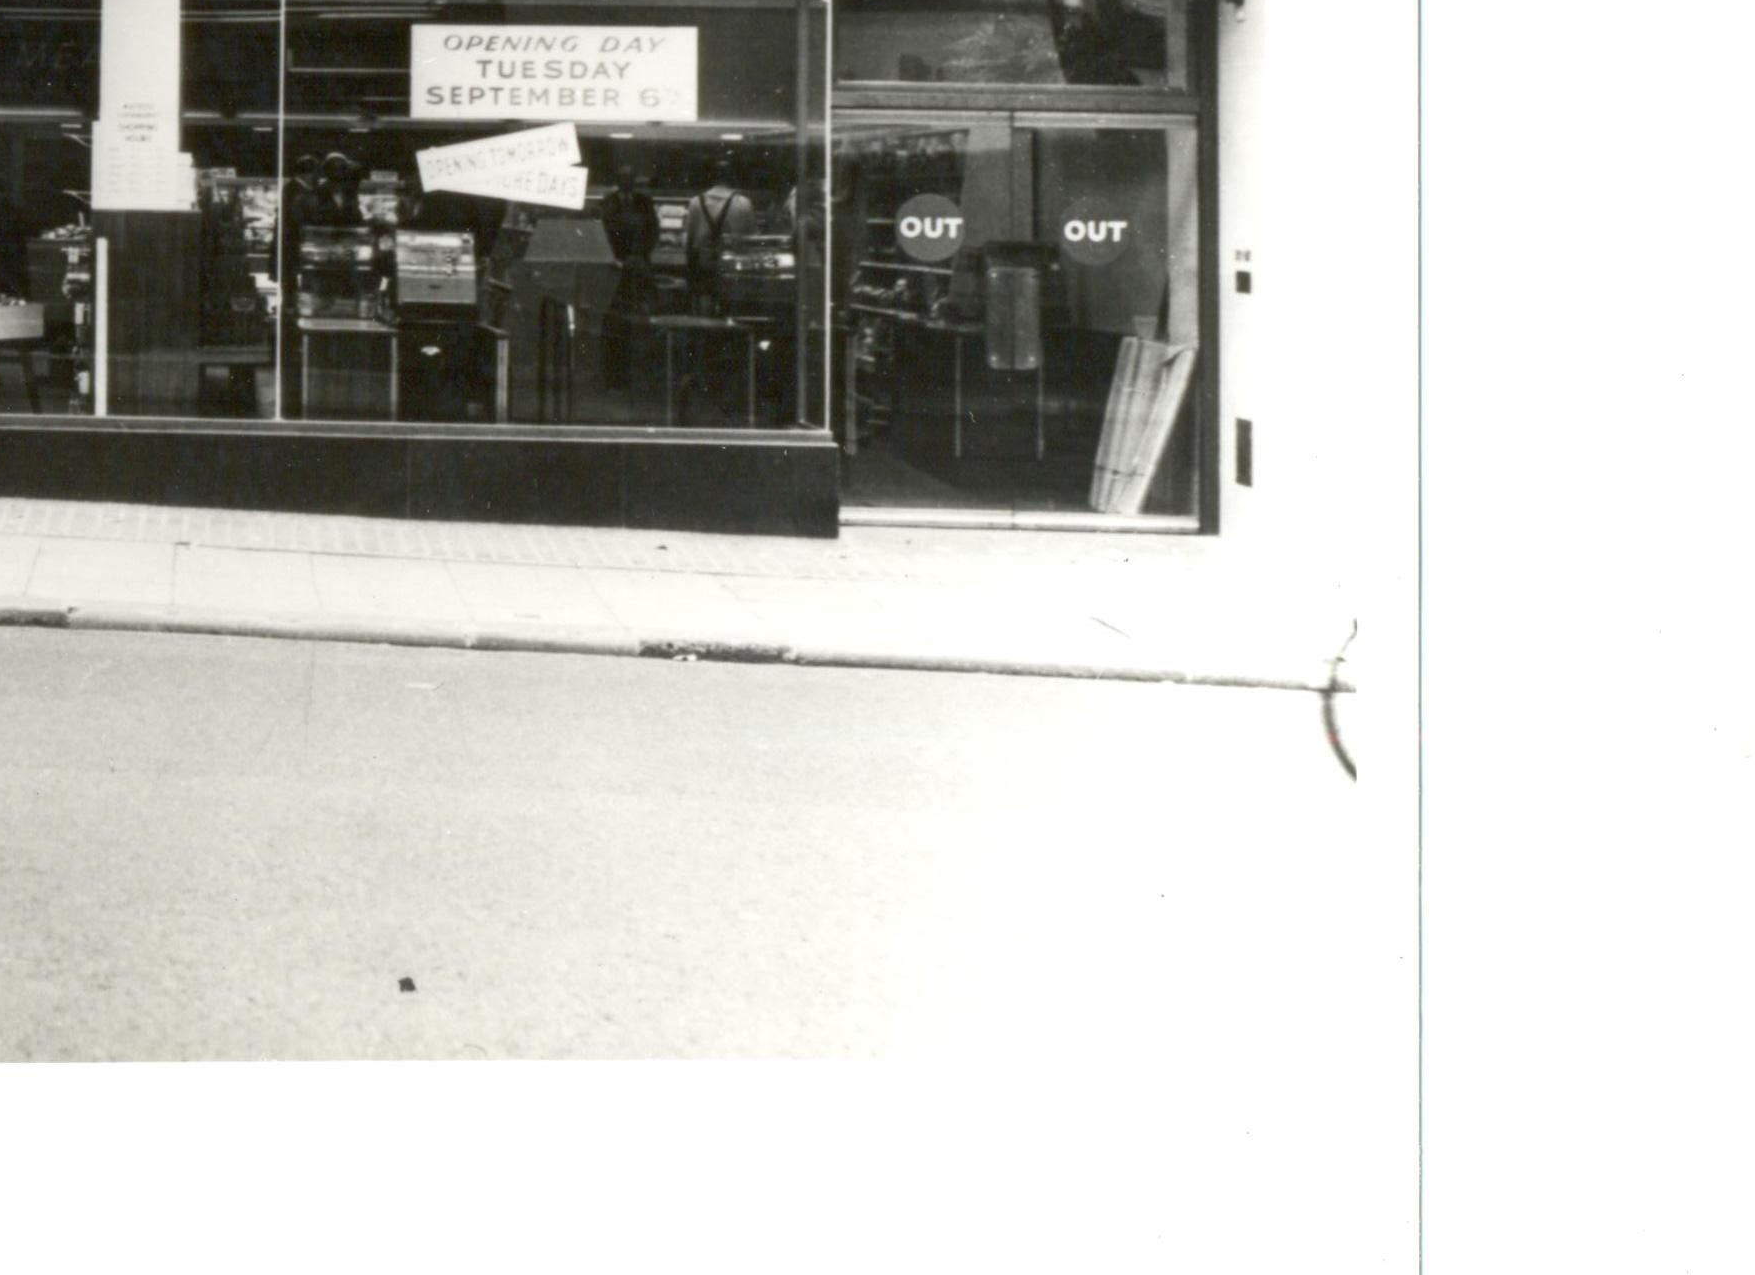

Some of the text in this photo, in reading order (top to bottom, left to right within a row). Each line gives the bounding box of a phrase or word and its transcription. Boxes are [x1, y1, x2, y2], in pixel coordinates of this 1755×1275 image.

[442, 33, 667, 54] OPENING DAY
[475, 58, 632, 81] TUESDAY
[424, 85, 621, 108] SEPTEMBER
[899, 216, 964, 239] OUT
[1063, 219, 1128, 242] OUT
